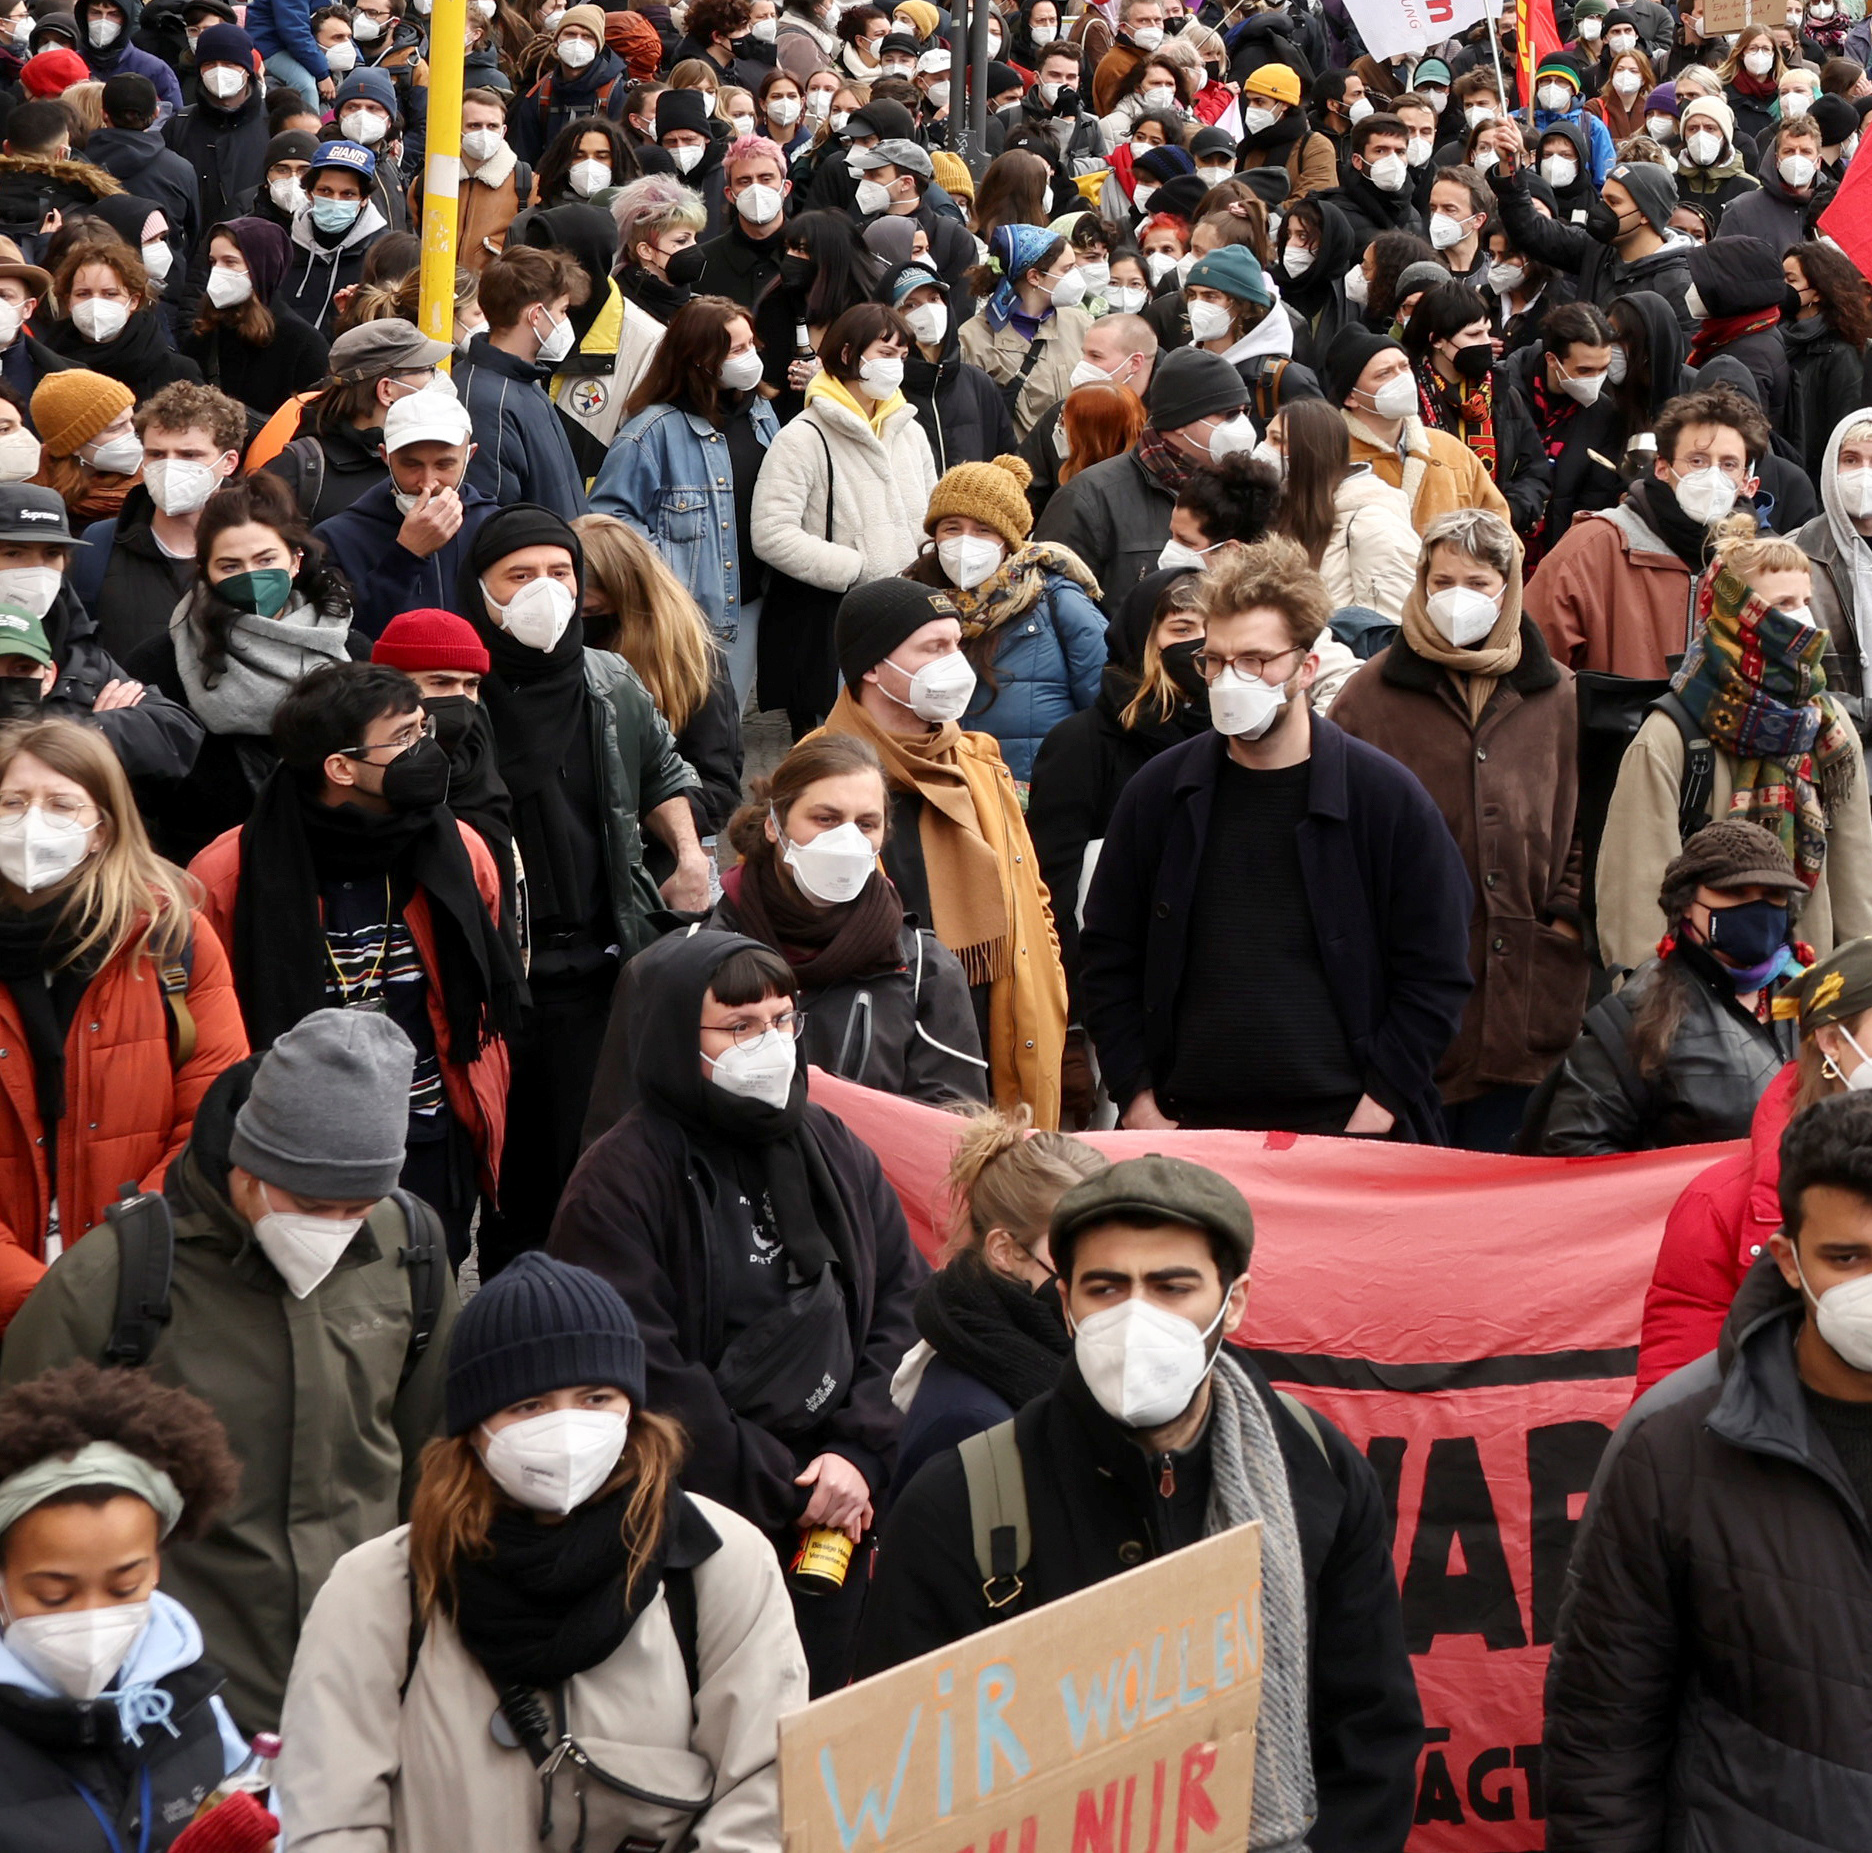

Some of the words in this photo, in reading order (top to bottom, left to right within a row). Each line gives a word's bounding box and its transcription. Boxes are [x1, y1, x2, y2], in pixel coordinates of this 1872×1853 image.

[328, 145, 369, 164] GIANTS
[19, 509, 60, 522] Supreme
[805, 1385, 824, 1407] Jack
[808, 1378, 838, 1413] Wolfskin
[1056, 1584, 1262, 1756] WOLLEN
[1072, 1742, 1223, 1853] NUR
